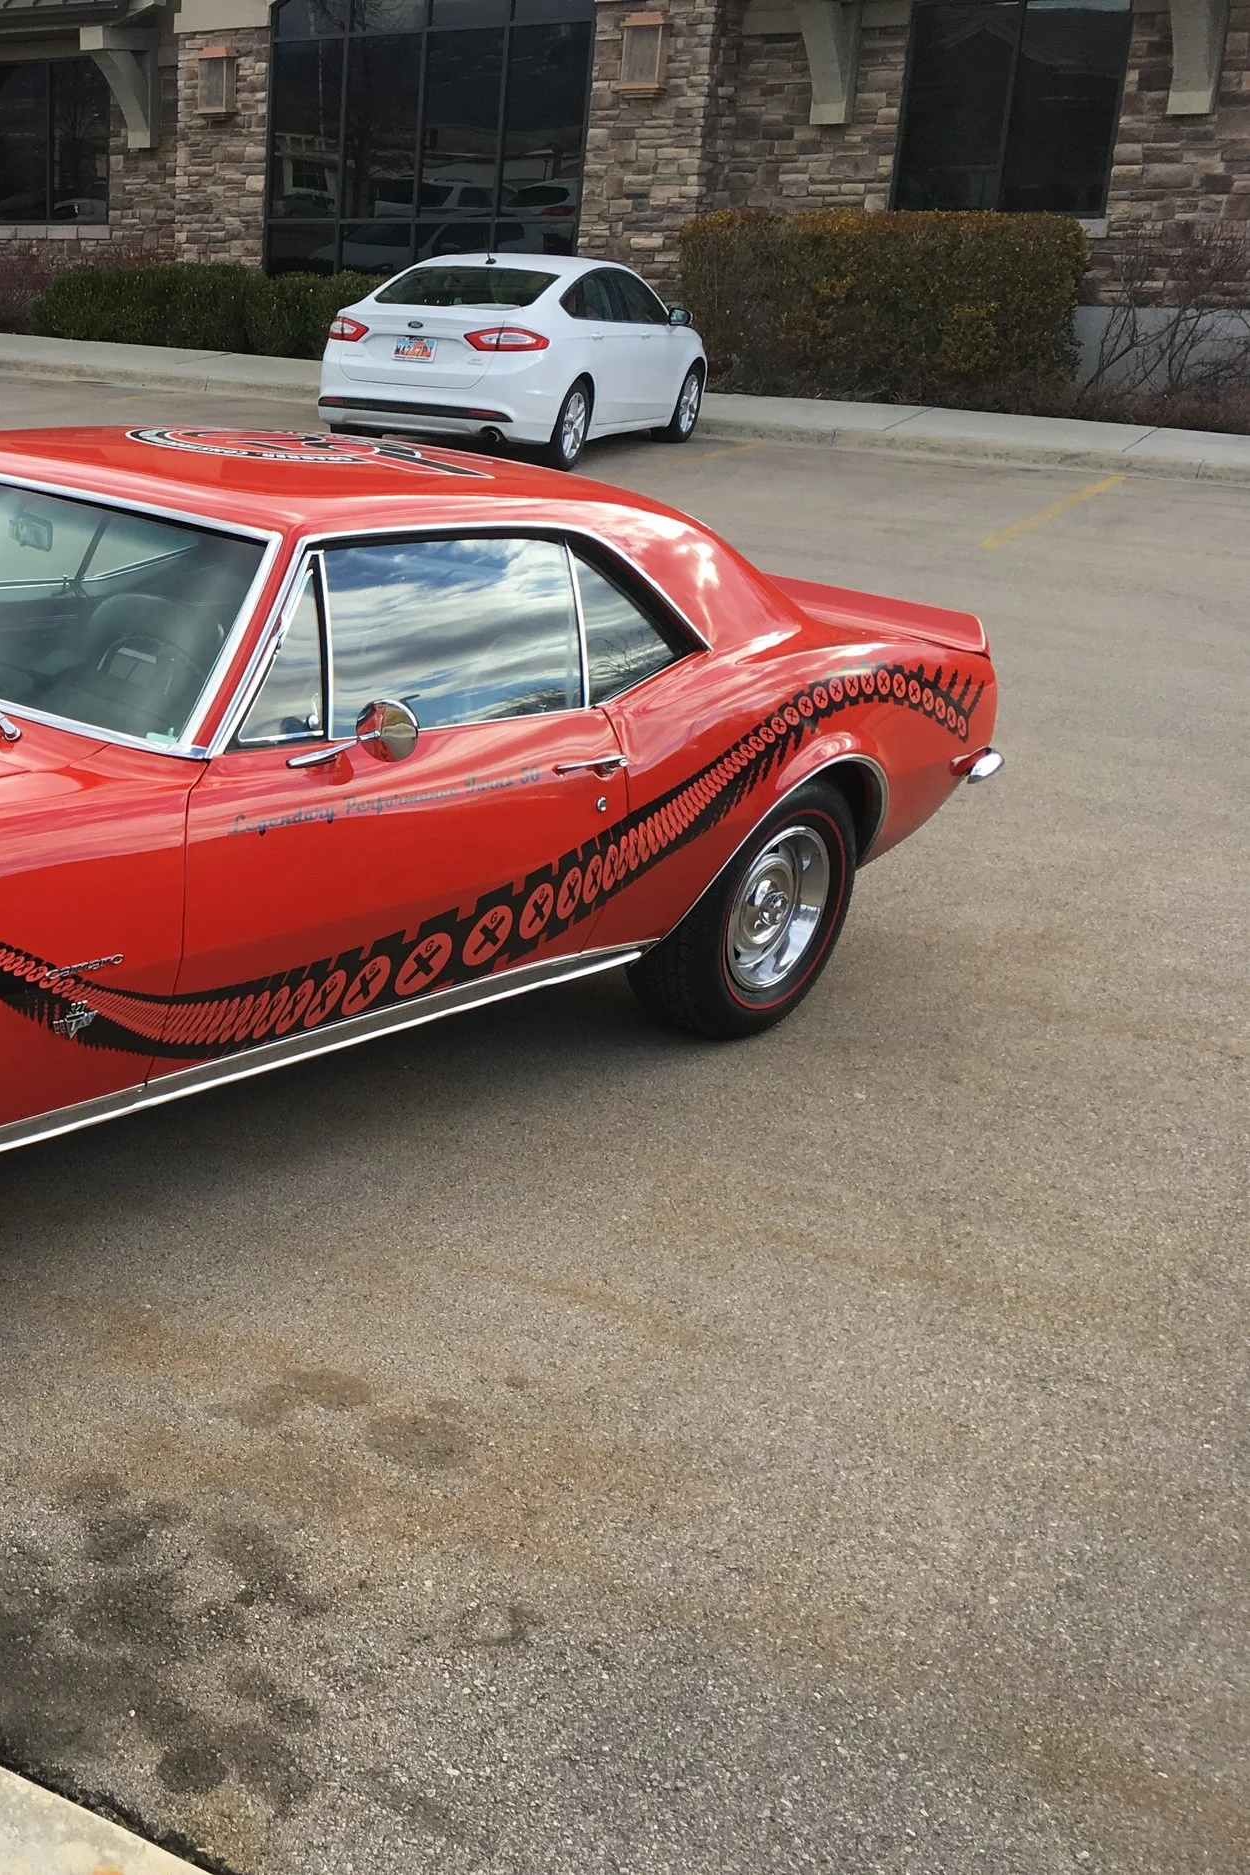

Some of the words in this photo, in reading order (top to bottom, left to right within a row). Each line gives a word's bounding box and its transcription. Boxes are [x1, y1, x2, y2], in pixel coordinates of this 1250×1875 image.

[227, 808, 336, 836] Legendary
[342, 787, 458, 815] Performance
[520, 766, 541, 785] 50
[45, 953, 124, 979] Camaro
